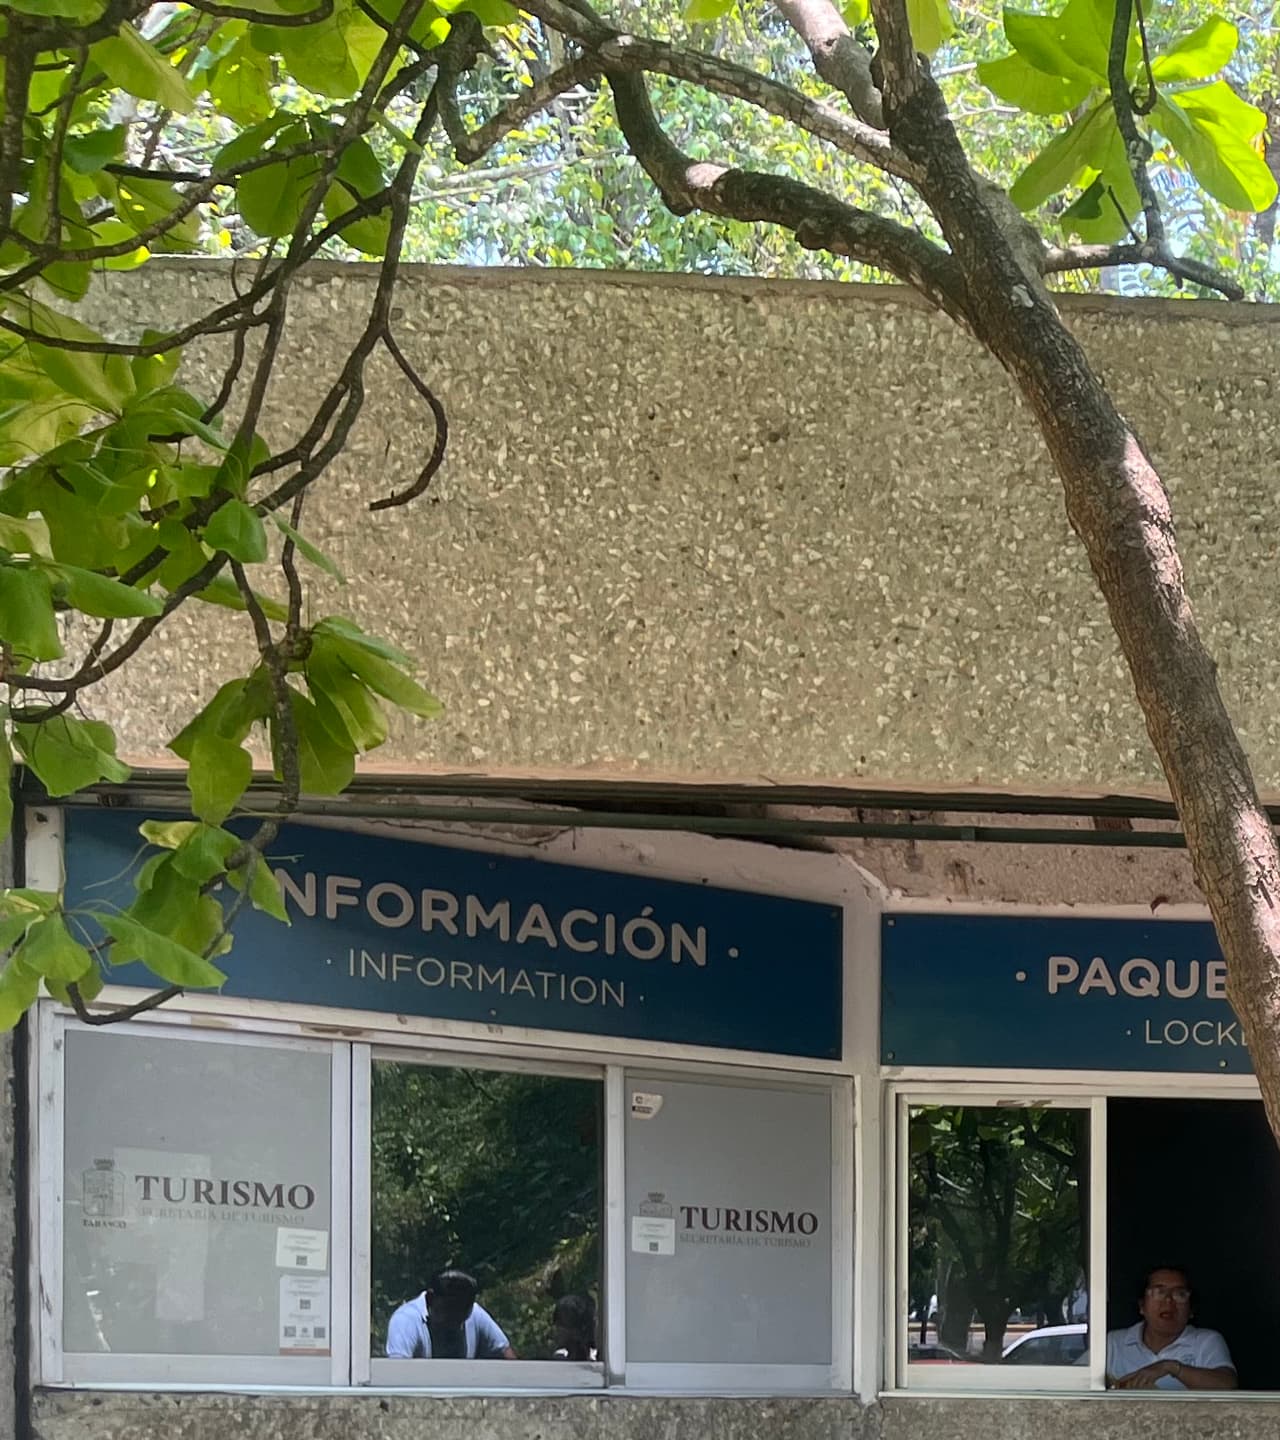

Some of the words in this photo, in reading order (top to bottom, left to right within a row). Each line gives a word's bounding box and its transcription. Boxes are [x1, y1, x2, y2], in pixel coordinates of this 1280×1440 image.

[253, 868, 707, 966] NFORMACIÓN
[350, 948, 625, 1008] INFORMATION
[1145, 1019, 1249, 1047] LOCK
[135, 1175, 315, 1210] TURISMO
[680, 1206, 819, 1235] TURISMO
